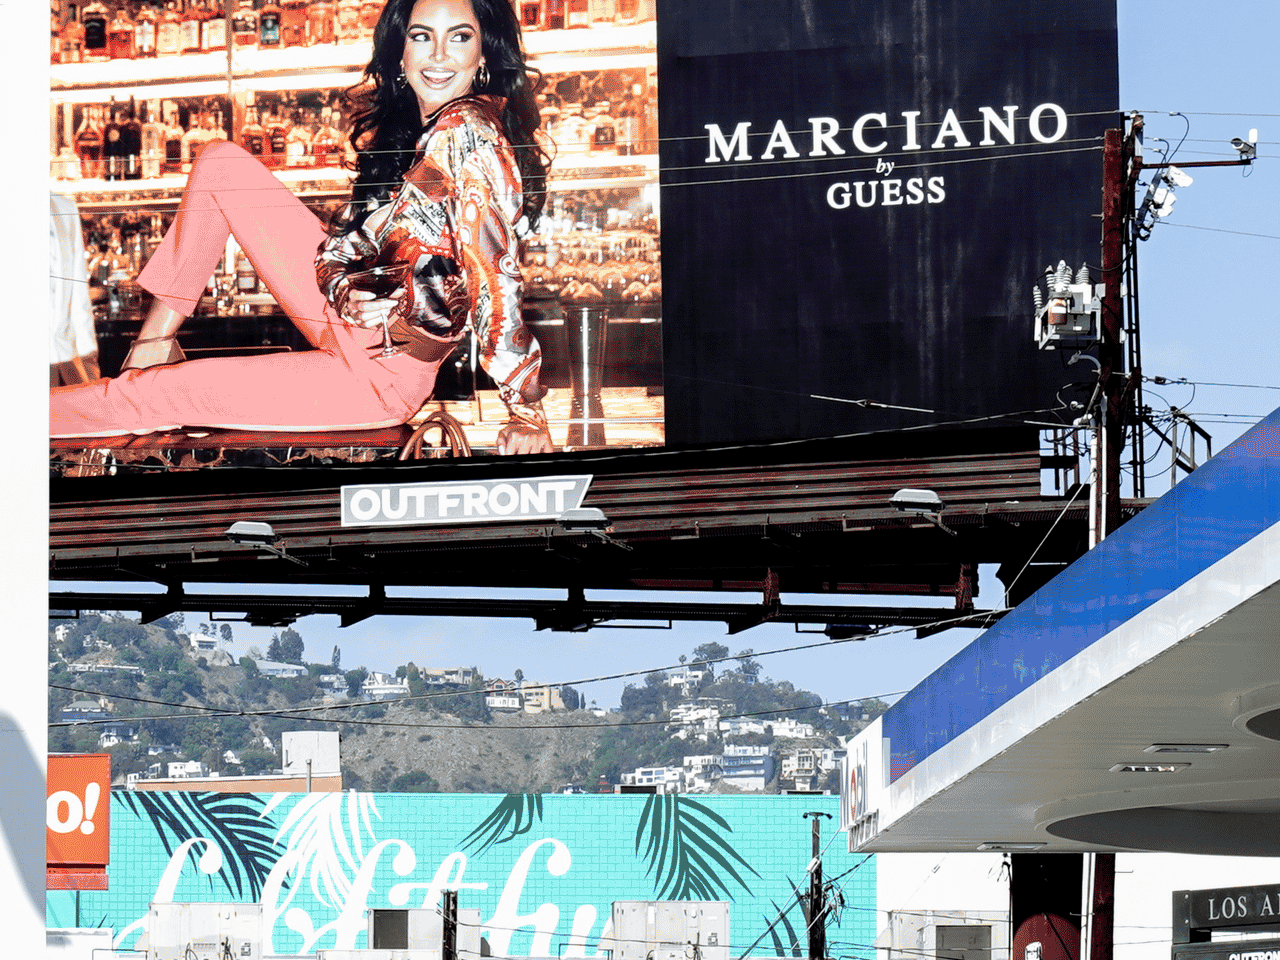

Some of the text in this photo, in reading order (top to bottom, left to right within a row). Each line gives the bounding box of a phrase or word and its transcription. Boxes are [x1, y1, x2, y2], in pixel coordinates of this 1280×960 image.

[704, 103, 1068, 163] MARCIANO
[875, 158, 895, 176] by
[826, 176, 946, 209] GUESS
[350, 480, 577, 521] OUTFRONT
[1208, 895, 1248, 921] LOS
